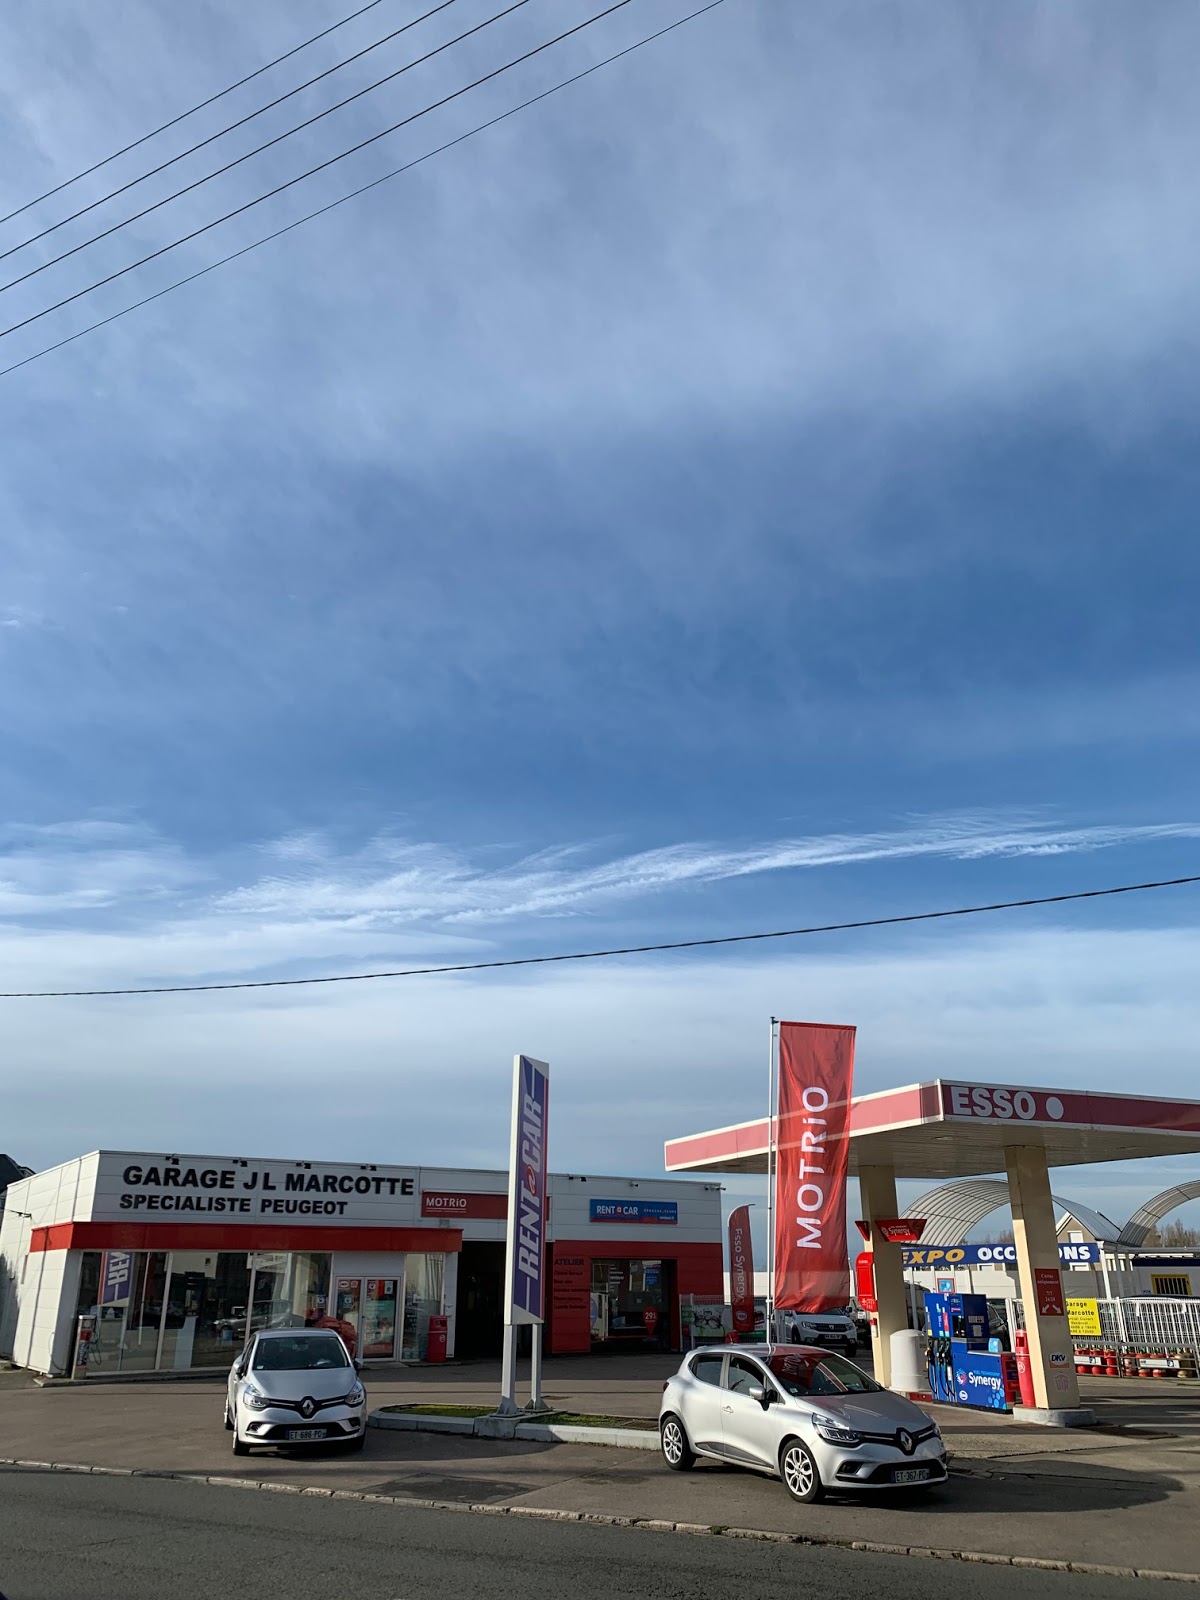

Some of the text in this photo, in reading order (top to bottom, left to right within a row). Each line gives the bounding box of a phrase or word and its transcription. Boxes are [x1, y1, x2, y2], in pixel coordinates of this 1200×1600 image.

[950, 1086, 1036, 1120] ESSO
[522, 1093, 542, 1173] CAR
[123, 1165, 236, 1189] GARAGE
[285, 1173, 414, 1196] MARCOTTE
[120, 1194, 348, 1215] SPECIALISTE PEUGEOT
[596, 1205, 616, 1215] RENT
[622, 1206, 639, 1216] CAR
[518, 1180, 540, 1280] RENT
[554, 1258, 585, 1266] ATELIER
[968, 1371, 1001, 1390] Synergy
